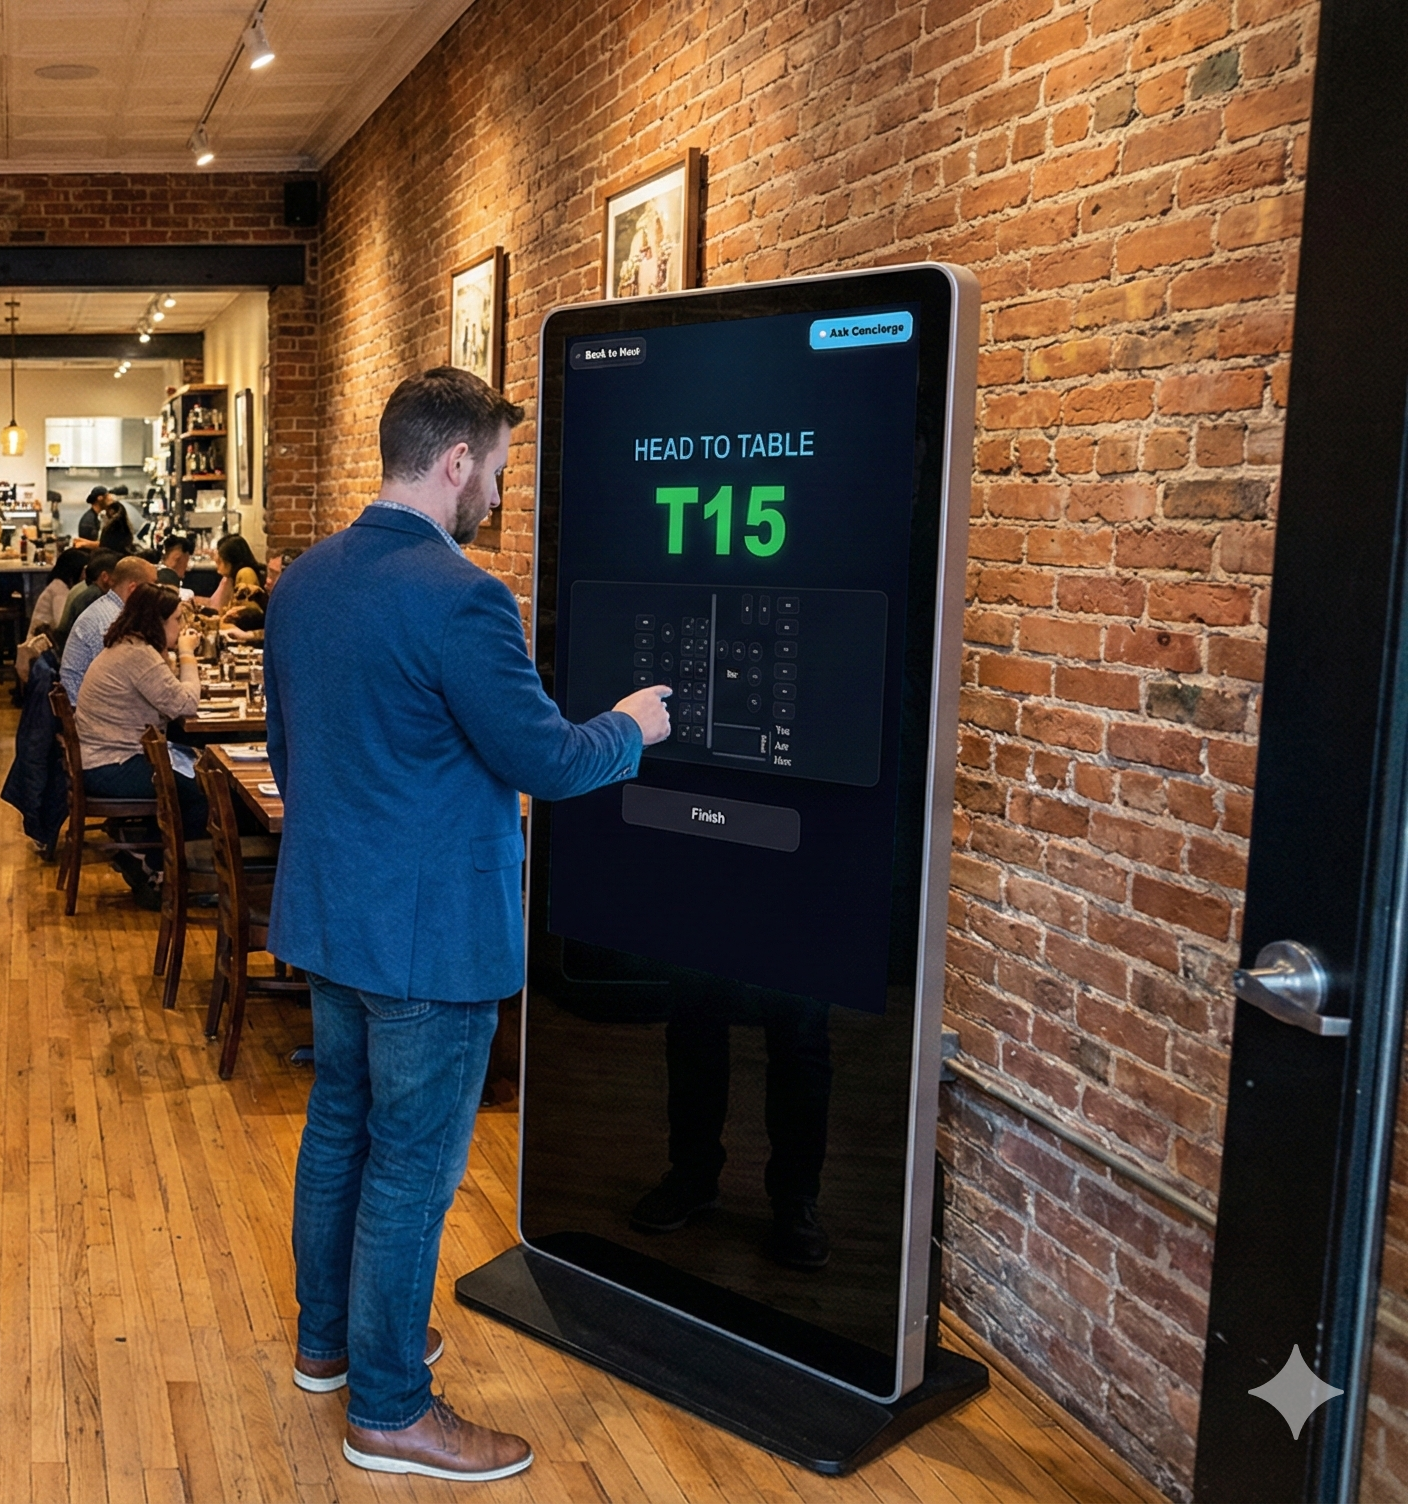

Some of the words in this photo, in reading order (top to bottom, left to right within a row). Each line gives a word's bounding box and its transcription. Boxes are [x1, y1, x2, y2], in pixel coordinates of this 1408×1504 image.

[635, 436, 694, 462] HEAD
[700, 435, 731, 459] TO
[737, 431, 815, 458] TABLE
[655, 485, 787, 557] T15
[691, 807, 726, 825] Finish
